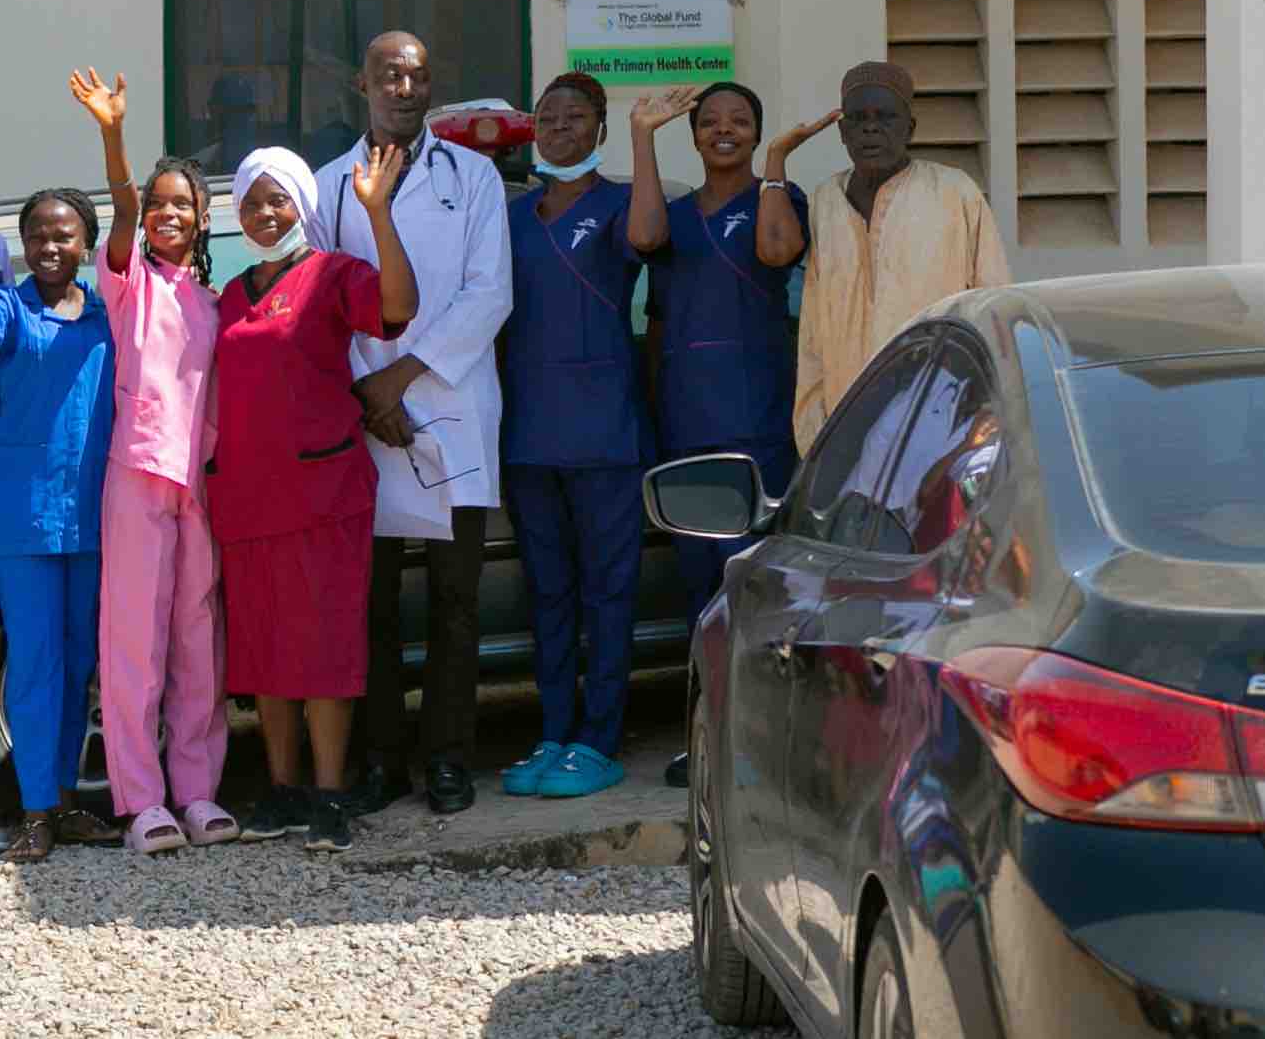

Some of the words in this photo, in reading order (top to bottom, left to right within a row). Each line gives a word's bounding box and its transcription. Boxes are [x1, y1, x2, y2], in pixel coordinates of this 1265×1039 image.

[618, 12, 637, 23] The
[640, 11, 672, 23] Global
[675, 11, 701, 22] Fund
[612, 57, 653, 74] Primary
[656, 57, 691, 71] Health
[694, 56, 728, 70] Center
